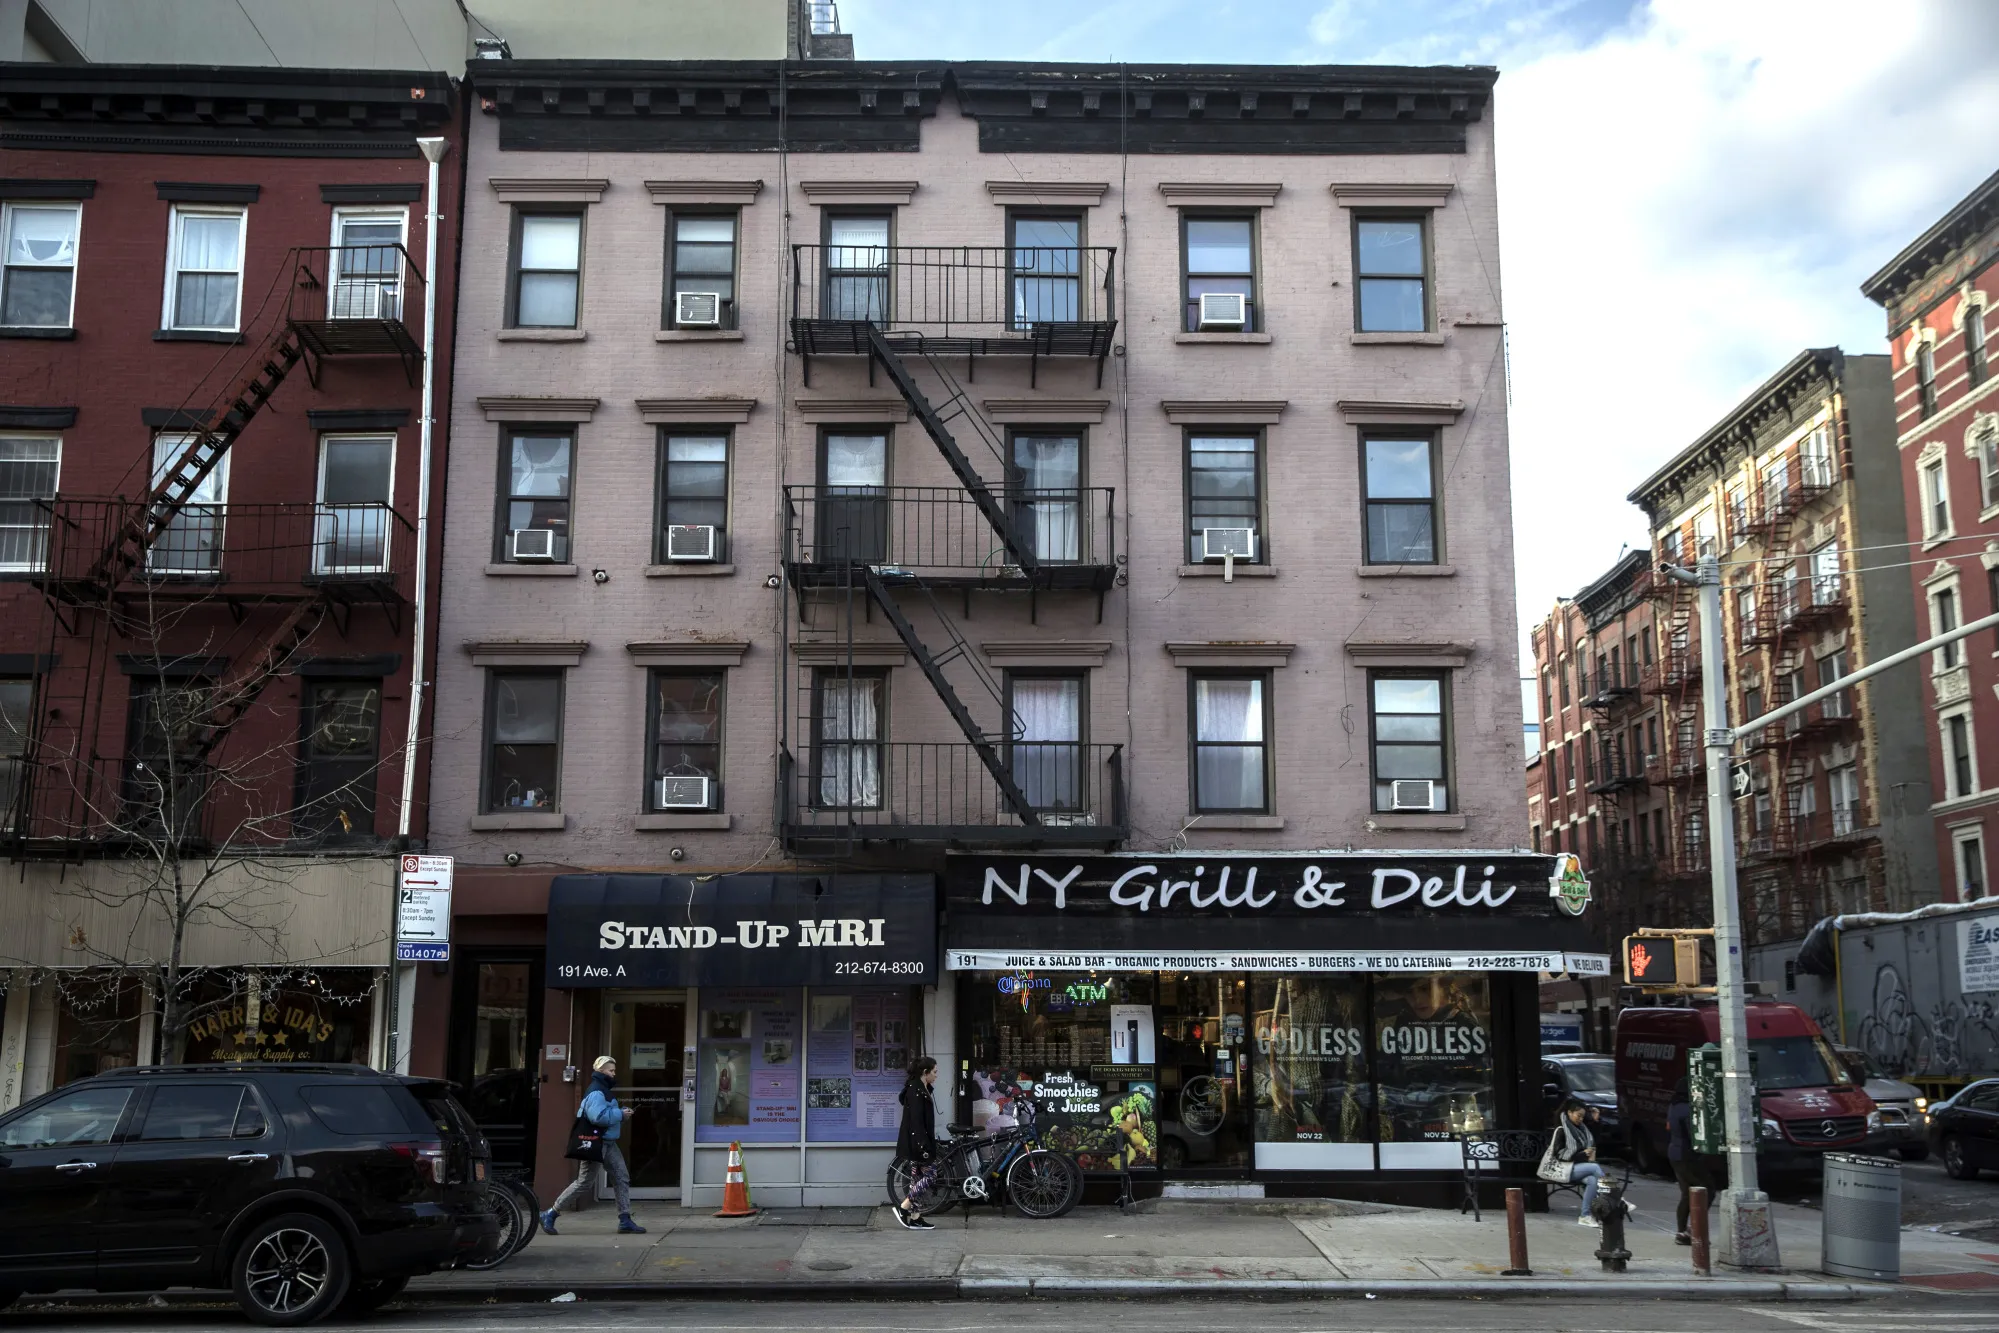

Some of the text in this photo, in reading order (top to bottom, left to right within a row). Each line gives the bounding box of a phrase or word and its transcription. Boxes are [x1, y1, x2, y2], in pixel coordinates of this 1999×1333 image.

[982, 863, 1517, 912] NY Grill & Deli
[402, 890, 411, 903] 2
[600, 918, 886, 950] STAND-UP MRI
[399, 949, 436, 958] 101407
[835, 962, 924, 974] 212-674-8300
[957, 955, 977, 966] 191
[1005, 956, 1035, 967] JUICE
[1038, 956, 1046, 967] &
[1050, 956, 1082, 967] SALAD
[1085, 957, 1105, 967] BAR
[1115, 957, 1159, 967] ORGANIC
[1164, 957, 1217, 967] PRODUCTS
[1231, 957, 1298, 967] SANDWICHES
[1309, 957, 1356, 967] BURGERS
[1366, 957, 1383, 968] WE
[1386, 957, 1399, 968] DO
[1402, 957, 1452, 968] CATERING
[1468, 957, 1550, 968] 212-228-7878
[1572, 959, 1603, 971] WE DELIVER
[558, 965, 626, 977] 191 Ave. A
[1050, 994, 1067, 1004] EBT
[1066, 985, 1106, 1000] ATM
[190, 1006, 250, 1042] HARR
[262, 1004, 277, 1024] &
[1258, 1026, 1362, 1056] GODLESS
[1382, 1026, 1486, 1054] GODLESS
[263, 1050, 295, 1062] Supply
[1626, 1042, 1676, 1060] APPROVED
[1045, 1072, 1073, 1084] Fresh
[1034, 1083, 1099, 1098] Smoothies
[1047, 1097, 1100, 1113] & Juices
